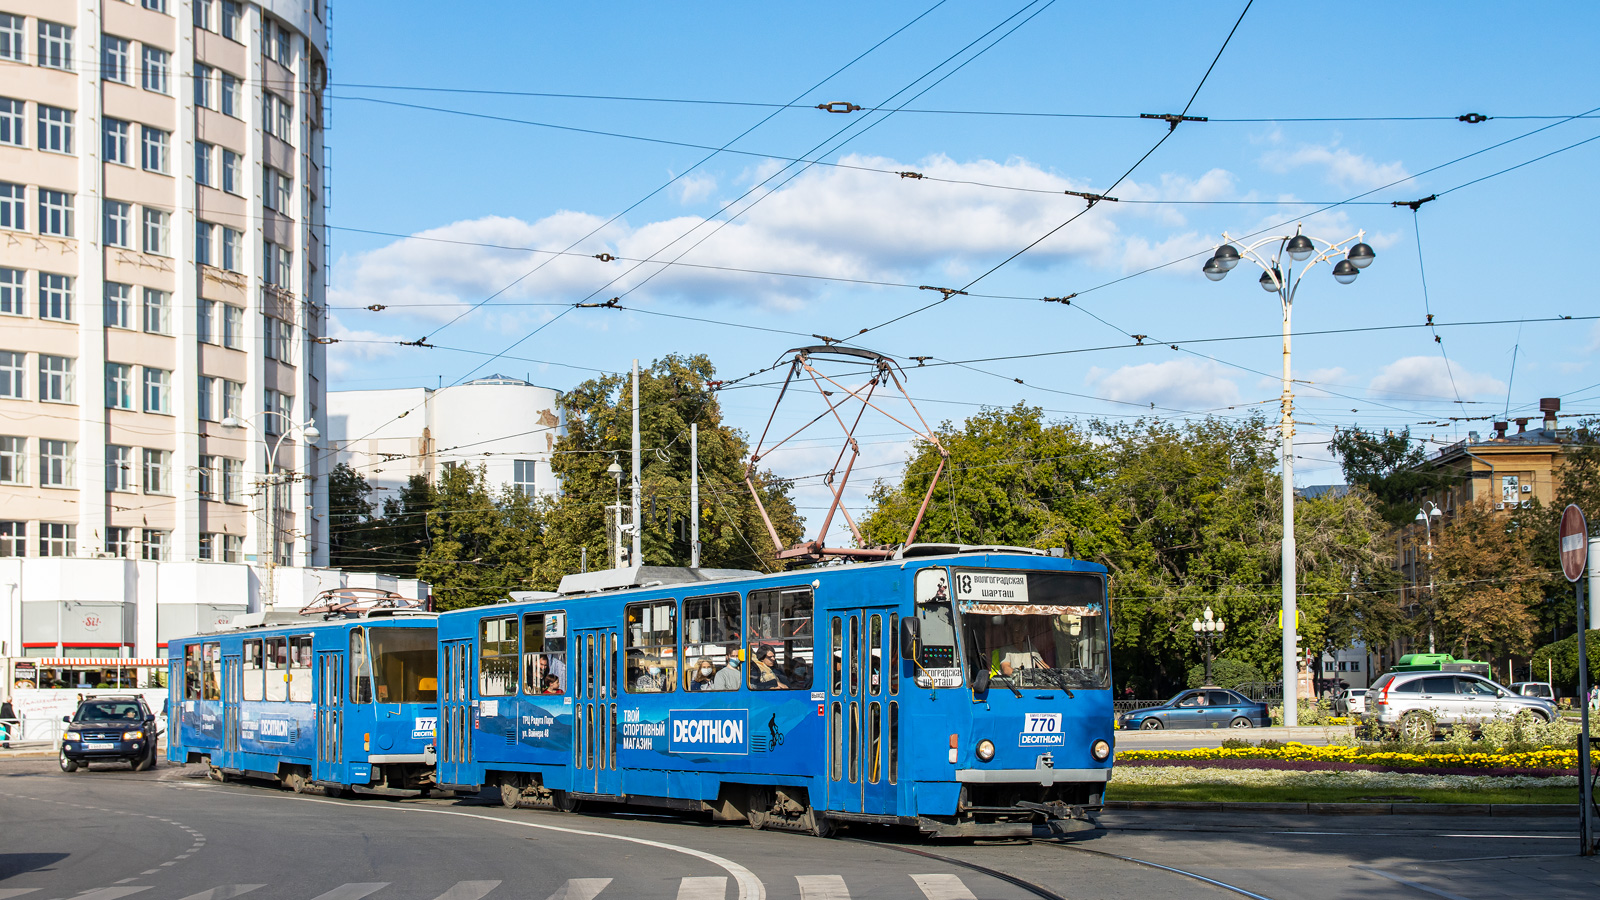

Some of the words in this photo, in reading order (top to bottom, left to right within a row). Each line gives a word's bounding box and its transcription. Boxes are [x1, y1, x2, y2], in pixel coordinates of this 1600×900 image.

[957, 574, 972, 594] 18
[917, 669, 961, 677] ВОЛГОГРАДСКА
[623, 707, 640, 722] ТВОЙ
[623, 721, 665, 737] СПОРТИВНЫЙ
[673, 719, 743, 744] DECATHLON
[1031, 718, 1056, 732] 770
[623, 737, 653, 750] МАГАЗИН
[1021, 735, 1062, 744] DECATHLON
